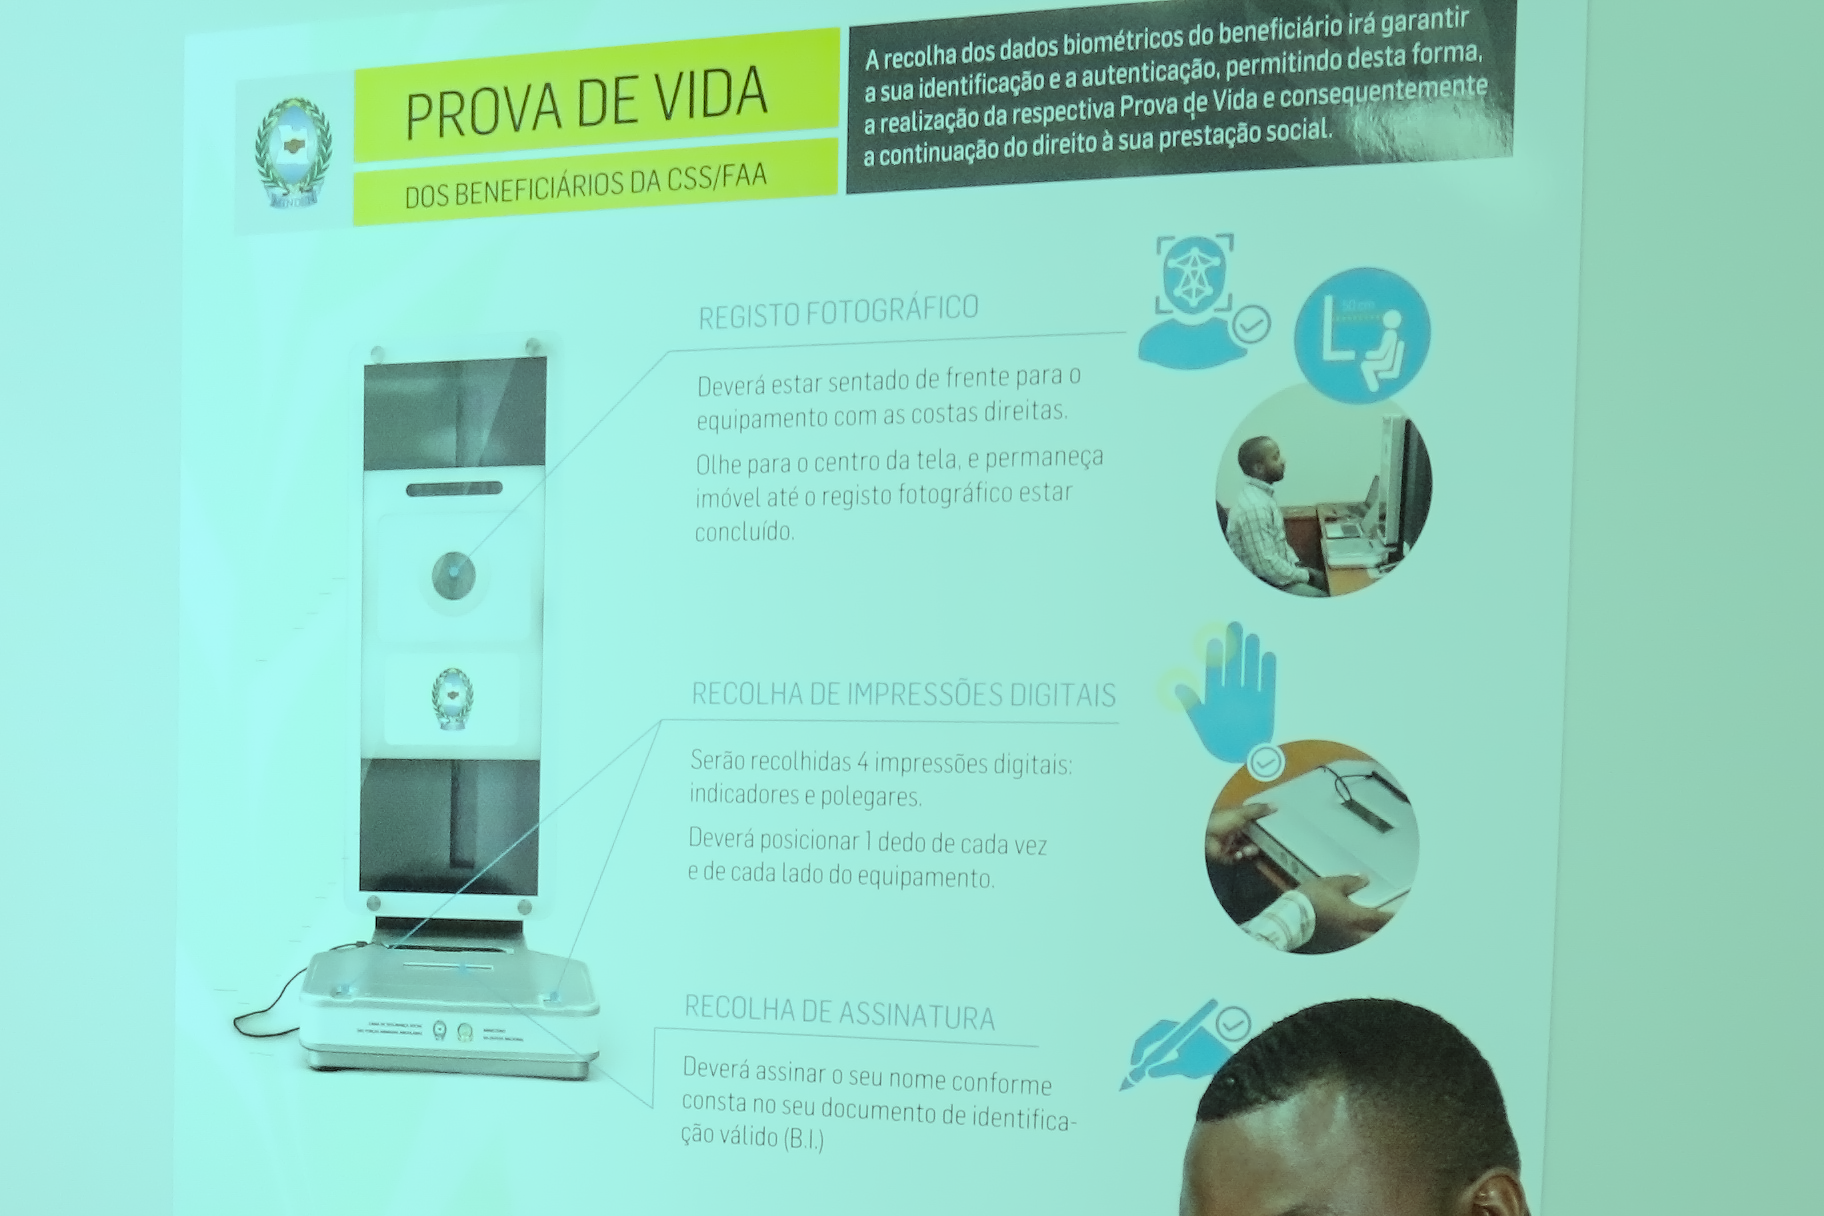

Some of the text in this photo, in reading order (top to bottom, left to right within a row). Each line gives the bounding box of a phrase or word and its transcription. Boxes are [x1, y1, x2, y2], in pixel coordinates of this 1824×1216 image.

[865, 5, 1470, 70] A recolha dos dados biométricos do beneficiário irá garantir
[865, 42, 1482, 103] a sua identificação e a autenticação, permitindo desta forma,
[408, 65, 768, 140] PROVA DE VIDA
[865, 75, 1488, 135] a realização da respectiva Prova de Vida e consequentemente
[864, 117, 1332, 167] a continuação do direito à sua prestação social.
[406, 162, 767, 209] DOS BENEFICIÁRIOS DA CSS/FAA
[700, 291, 979, 329] REGISTO FOTOGRÁFICO
[698, 366, 1081, 397] Deverá estar sentado de frente para o
[698, 400, 1067, 434] equipamento com as costas direitas.
[697, 448, 1103, 478] Olhe para o centro da tela, e permaneça
[697, 481, 1073, 511] imóvel até o registo fotográfico estar
[695, 520, 794, 542] concluído.
[693, 677, 1116, 708] RECOLHA DE IMPRESSÕES DIGITAIS
[691, 749, 1072, 779] Serão recolhidas 4 impressões digitais:
[691, 783, 922, 811] indicadores e polegares.
[689, 826, 1047, 855] Deverá posicionar 1 dedo de cada vez
[688, 861, 994, 890] e de cada lado do equipamento.
[686, 994, 995, 1031] RECOLHA DE ASSINATURA
[684, 1055, 1052, 1096] Deverá assinar o seu nome conforme
[683, 1093, 1076, 1131] consta no seu documento de identifica-
[681, 1123, 824, 1154] ção válido (B.I.)
